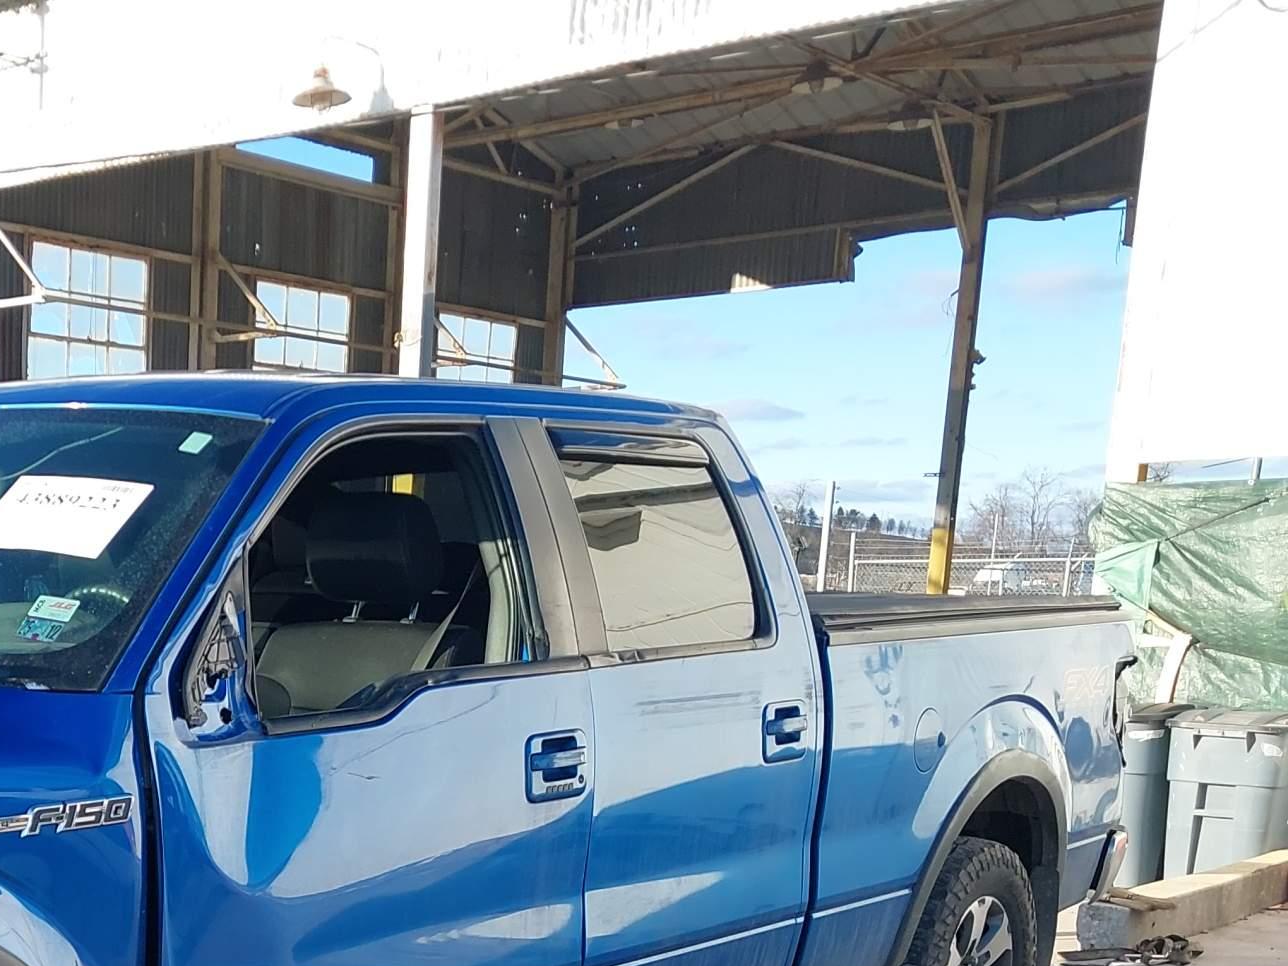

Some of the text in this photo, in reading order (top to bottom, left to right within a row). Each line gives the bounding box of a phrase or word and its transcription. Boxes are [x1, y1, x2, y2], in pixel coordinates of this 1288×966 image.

[45, 624, 63, 641] 12
[1063, 664, 1110, 700] FX4
[20, 794, 135, 838] F-150
